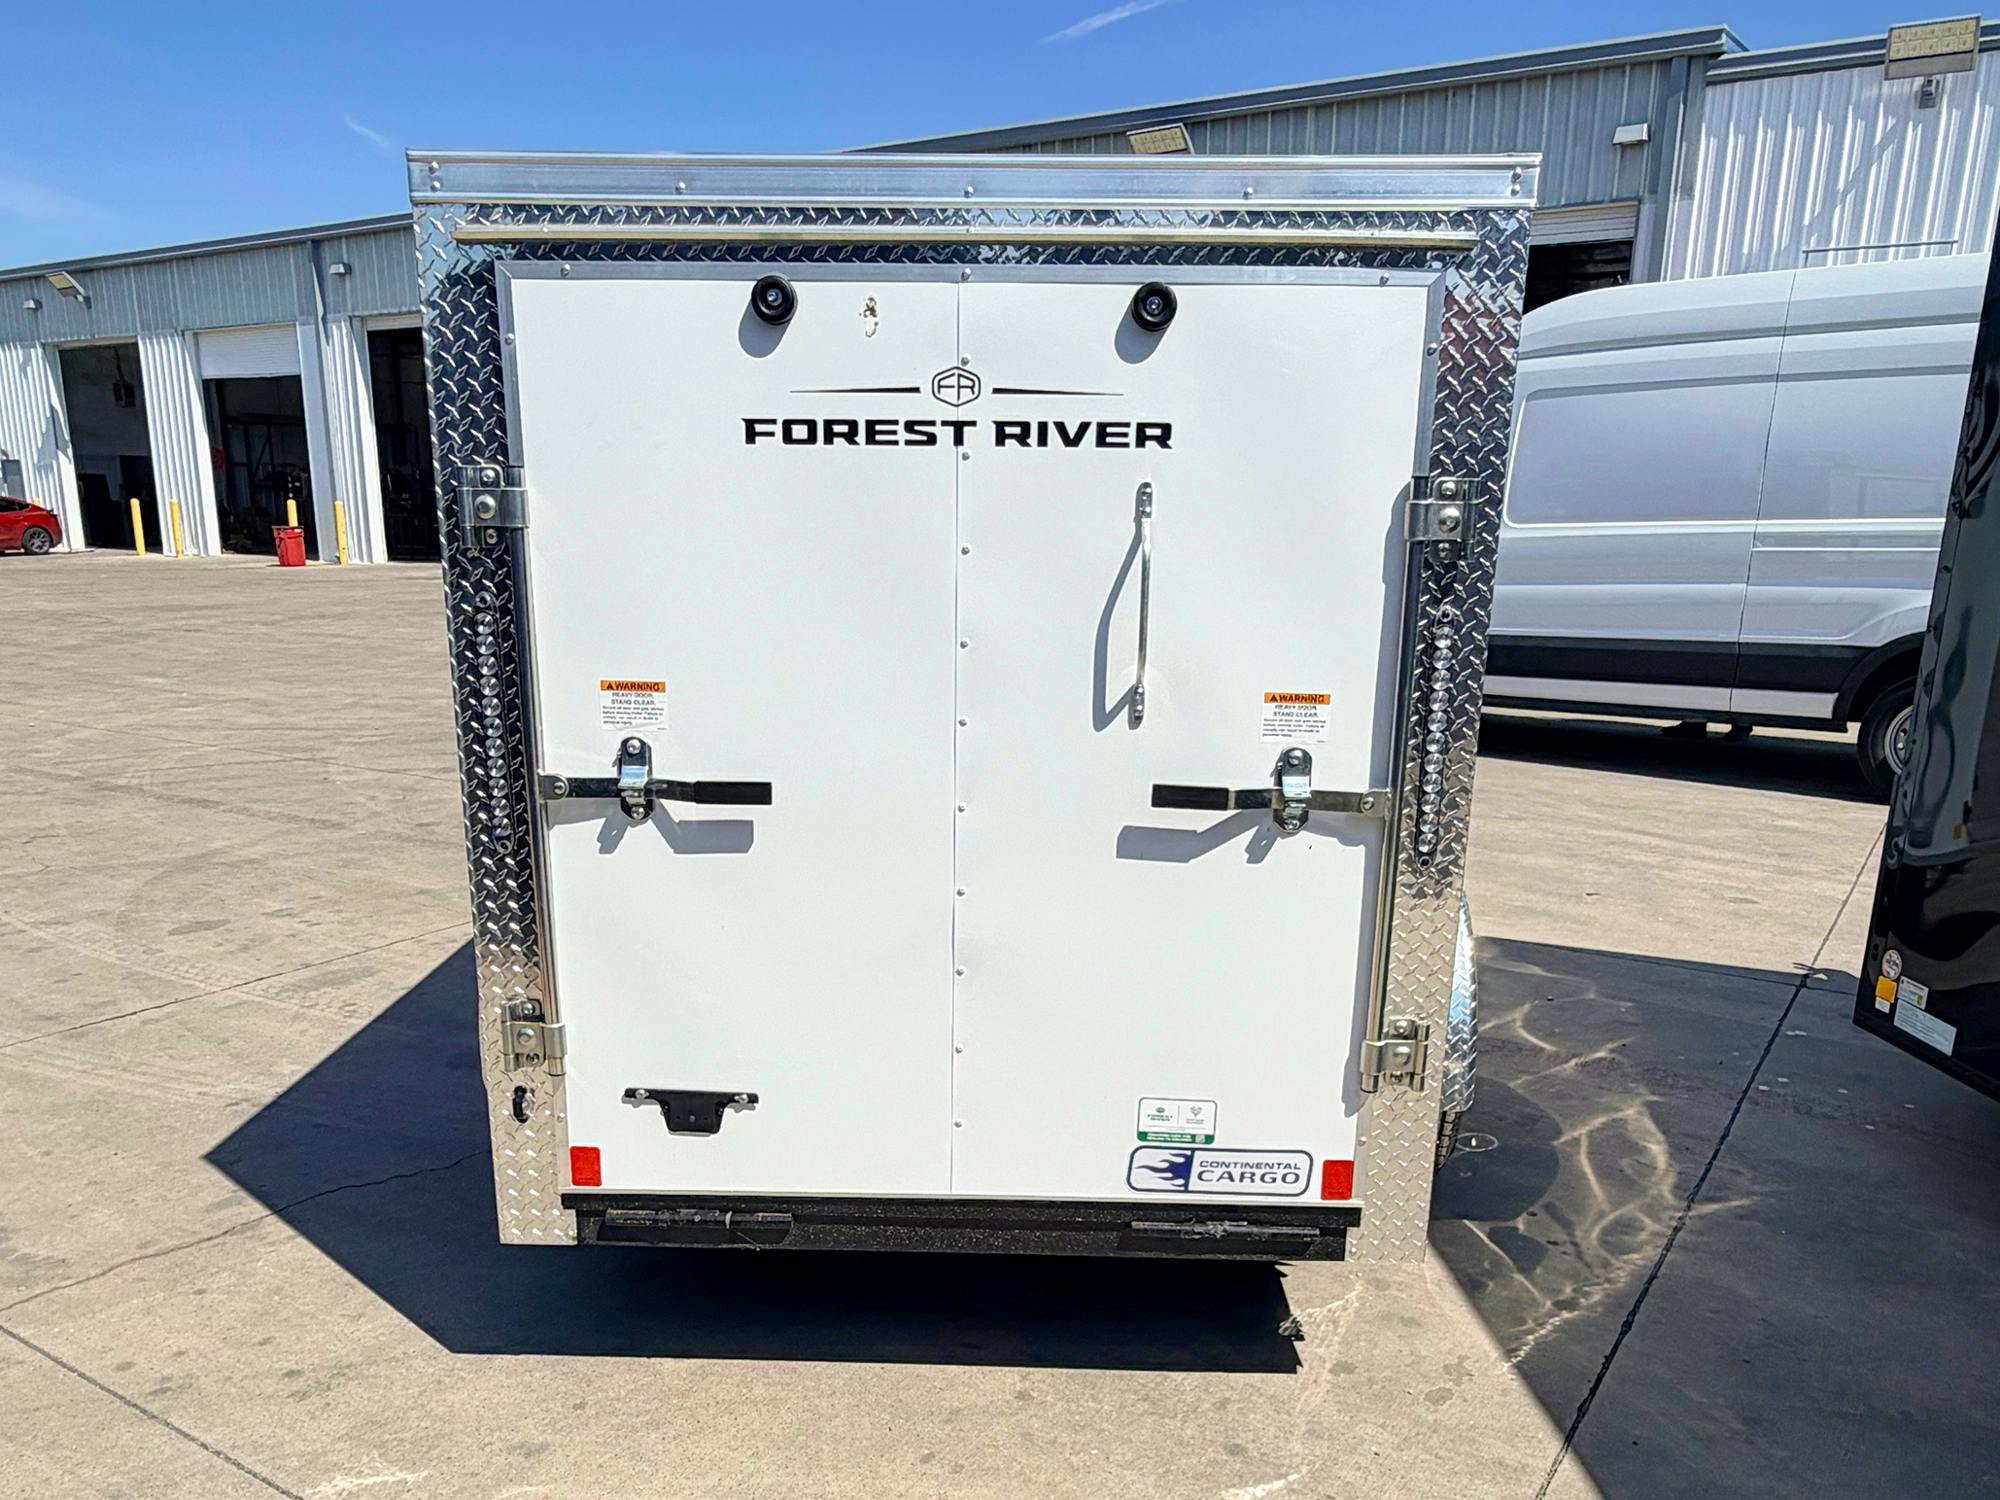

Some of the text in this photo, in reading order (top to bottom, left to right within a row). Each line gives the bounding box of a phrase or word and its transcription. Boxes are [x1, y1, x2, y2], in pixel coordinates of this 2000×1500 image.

[741, 417, 1173, 449] FOREST RIVER
[615, 681, 660, 692] WARNING
[1279, 694, 1324, 704] WARNING
[1199, 1160, 1301, 1170] CONTINENTAL
[1197, 1169, 1300, 1185] CARGO
